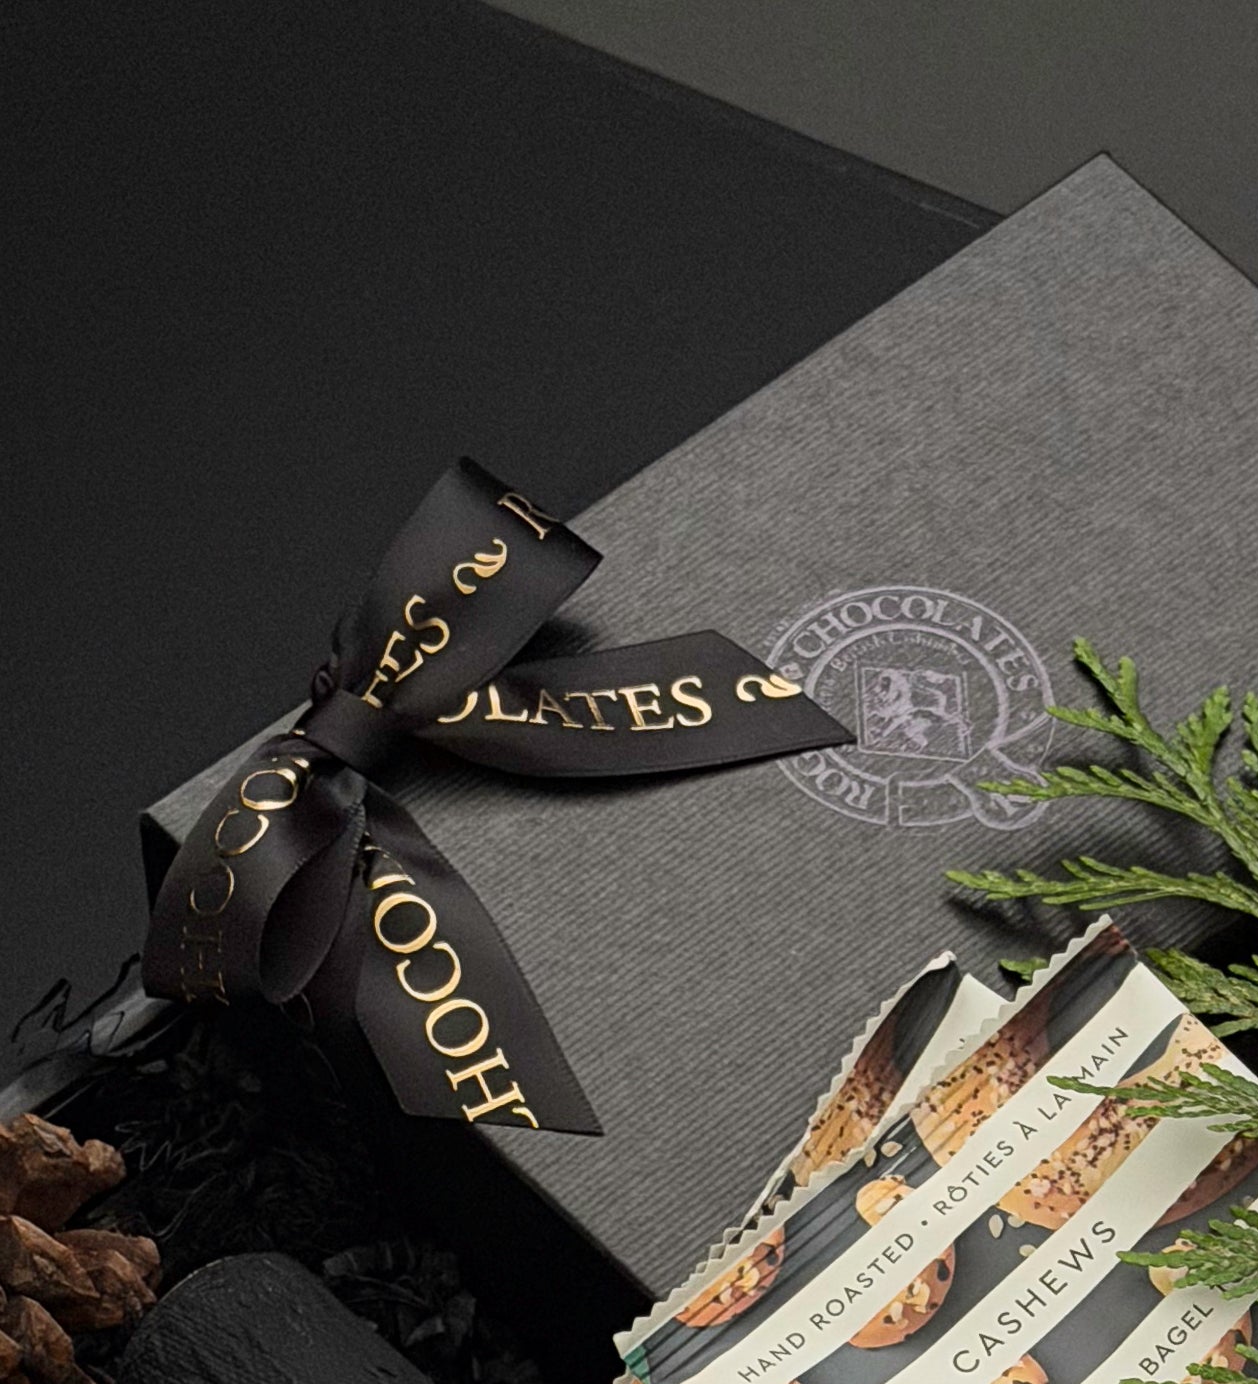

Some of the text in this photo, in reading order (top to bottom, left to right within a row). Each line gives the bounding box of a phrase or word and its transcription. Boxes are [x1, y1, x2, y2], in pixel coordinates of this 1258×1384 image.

[793, 595, 1039, 692] CHOCOLATES
[364, 846, 540, 1129] HOCO
[739, 1027, 1129, 1382] HAND ROASTED RÔTIES À LA MAIN
[952, 1219, 1118, 1374] CASHEWS
[1138, 1303, 1215, 1377] BAGEL
